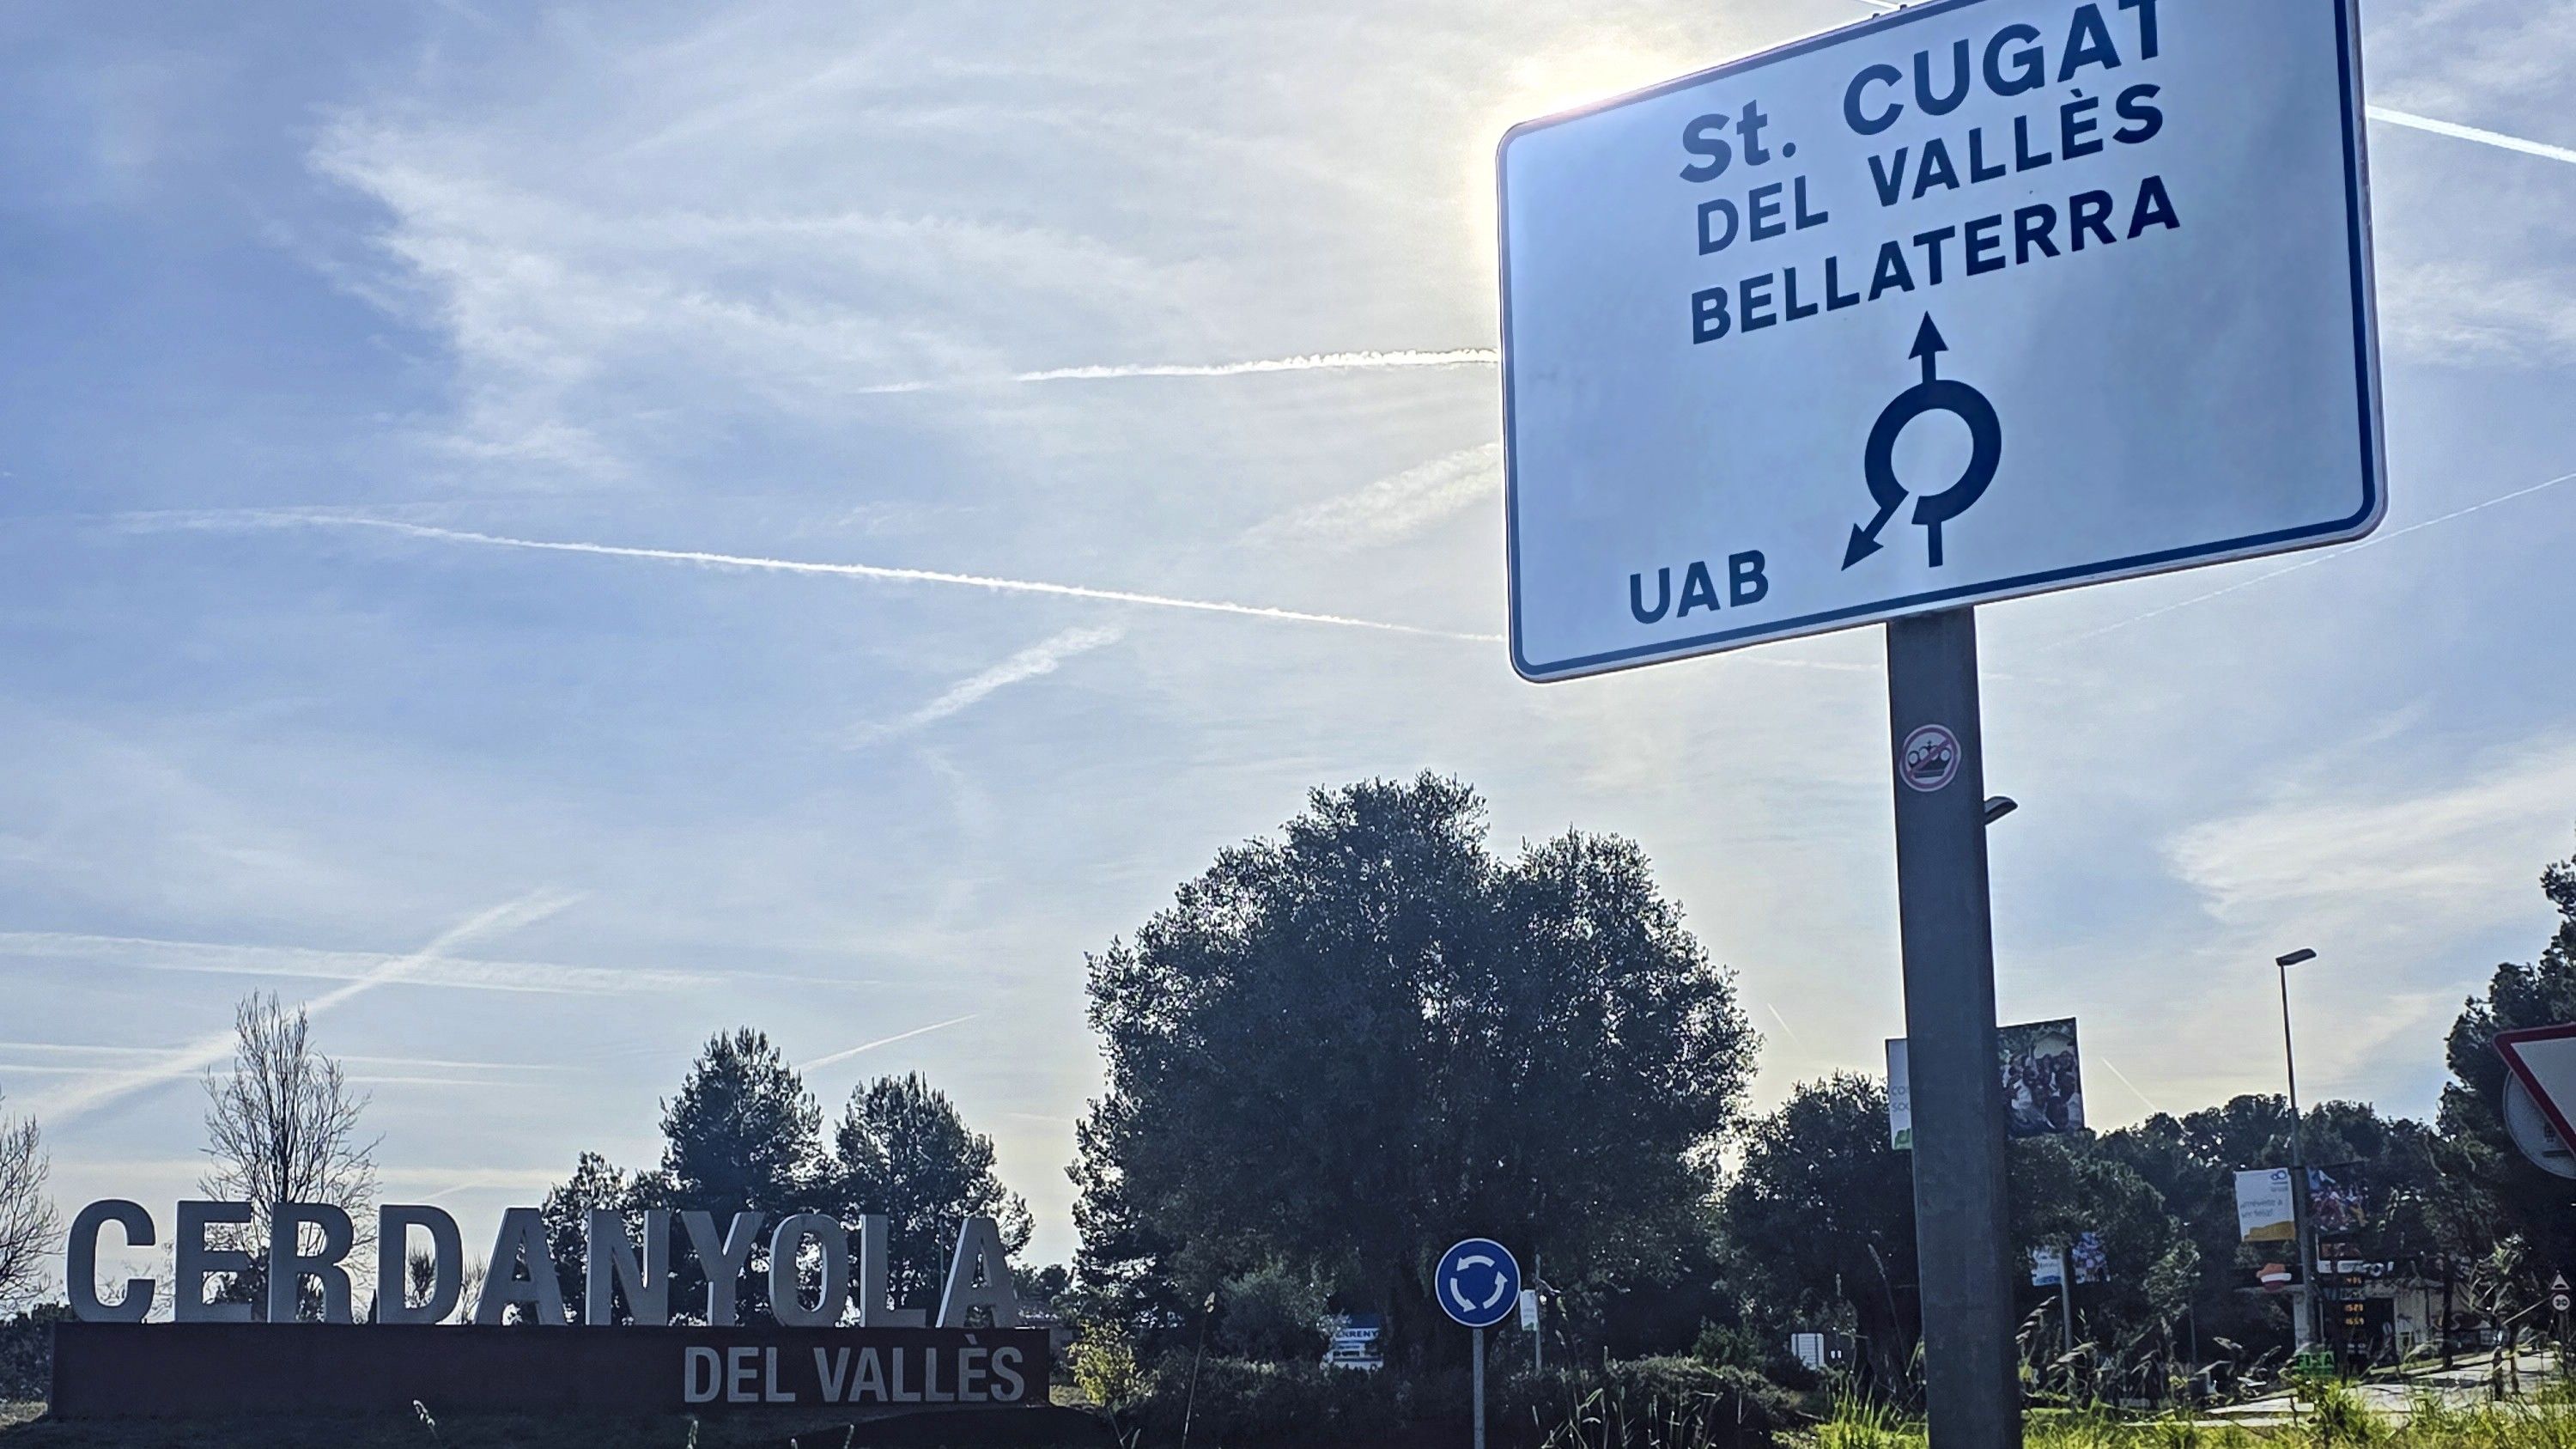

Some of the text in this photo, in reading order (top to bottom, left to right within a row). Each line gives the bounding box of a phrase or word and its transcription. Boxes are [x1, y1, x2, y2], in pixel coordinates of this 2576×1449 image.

[1680, 0, 2159, 183] St. CUGAT
[1698, 83, 2163, 256] DEL VALLÈS
[1692, 175, 2180, 345] BELLATERRA
[1630, 550, 1768, 624] UAB
[68, 1199, 1019, 1328] CERDANYOLA
[686, 1334, 1025, 1403] DEL VALLÈS
